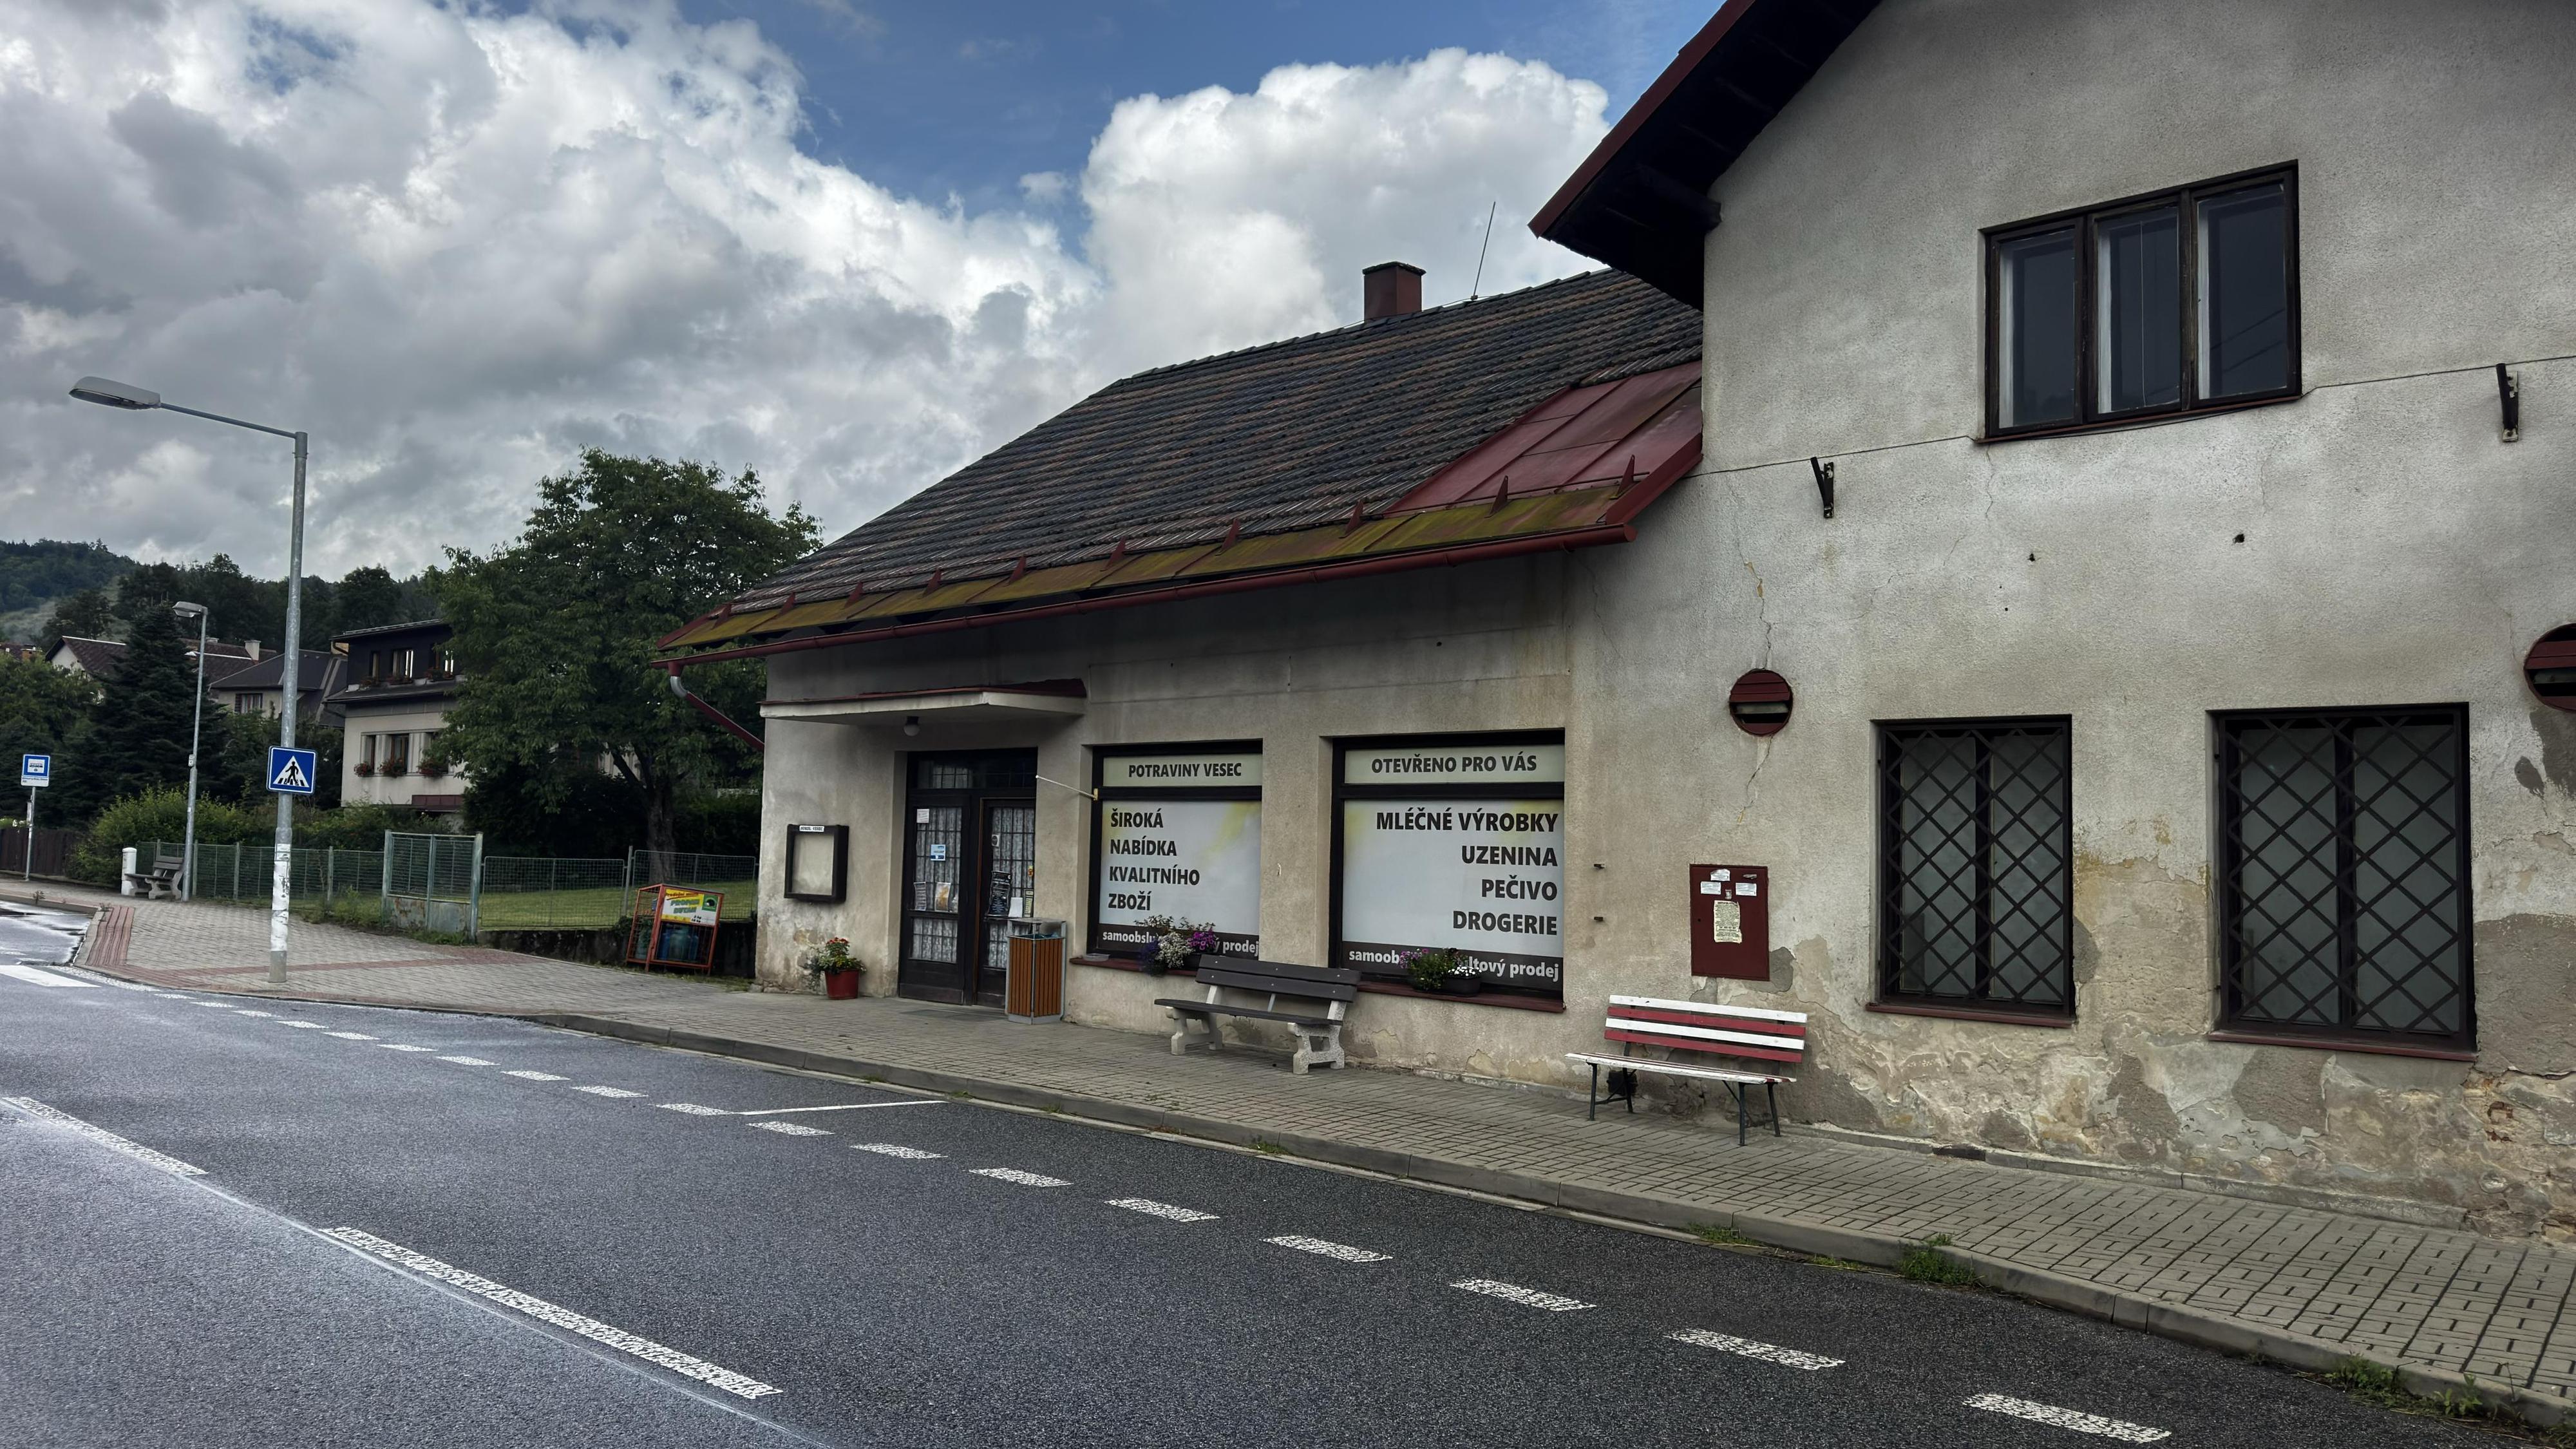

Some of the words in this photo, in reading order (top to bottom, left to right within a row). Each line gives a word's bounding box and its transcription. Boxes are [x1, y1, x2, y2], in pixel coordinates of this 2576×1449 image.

[1128, 764, 1200, 777] POTRAVINY
[1204, 763, 1242, 777] VESEC
[1371, 753, 1456, 773] OTEVŘENO
[1461, 756, 1496, 772] PRO
[1501, 752, 1537, 772] VÁS
[1110, 808, 1164, 828] ŠIROKÁ
[1376, 807, 1453, 831] MLÉČNÉ
[1458, 808, 1558, 832] VÝROBKY
[1110, 835, 1177, 856] NABÍDKA
[1461, 846, 1558, 866] UZENINA
[1109, 864, 1200, 886] KVALITNÍHO
[1481, 875, 1557, 901] PEČIVO
[1108, 891, 1152, 911] ZBOŽÍ
[1453, 911, 1557, 935] DROGERIE
[1223, 940, 1259, 956] prodej
[1510, 961, 1558, 982] prodej
